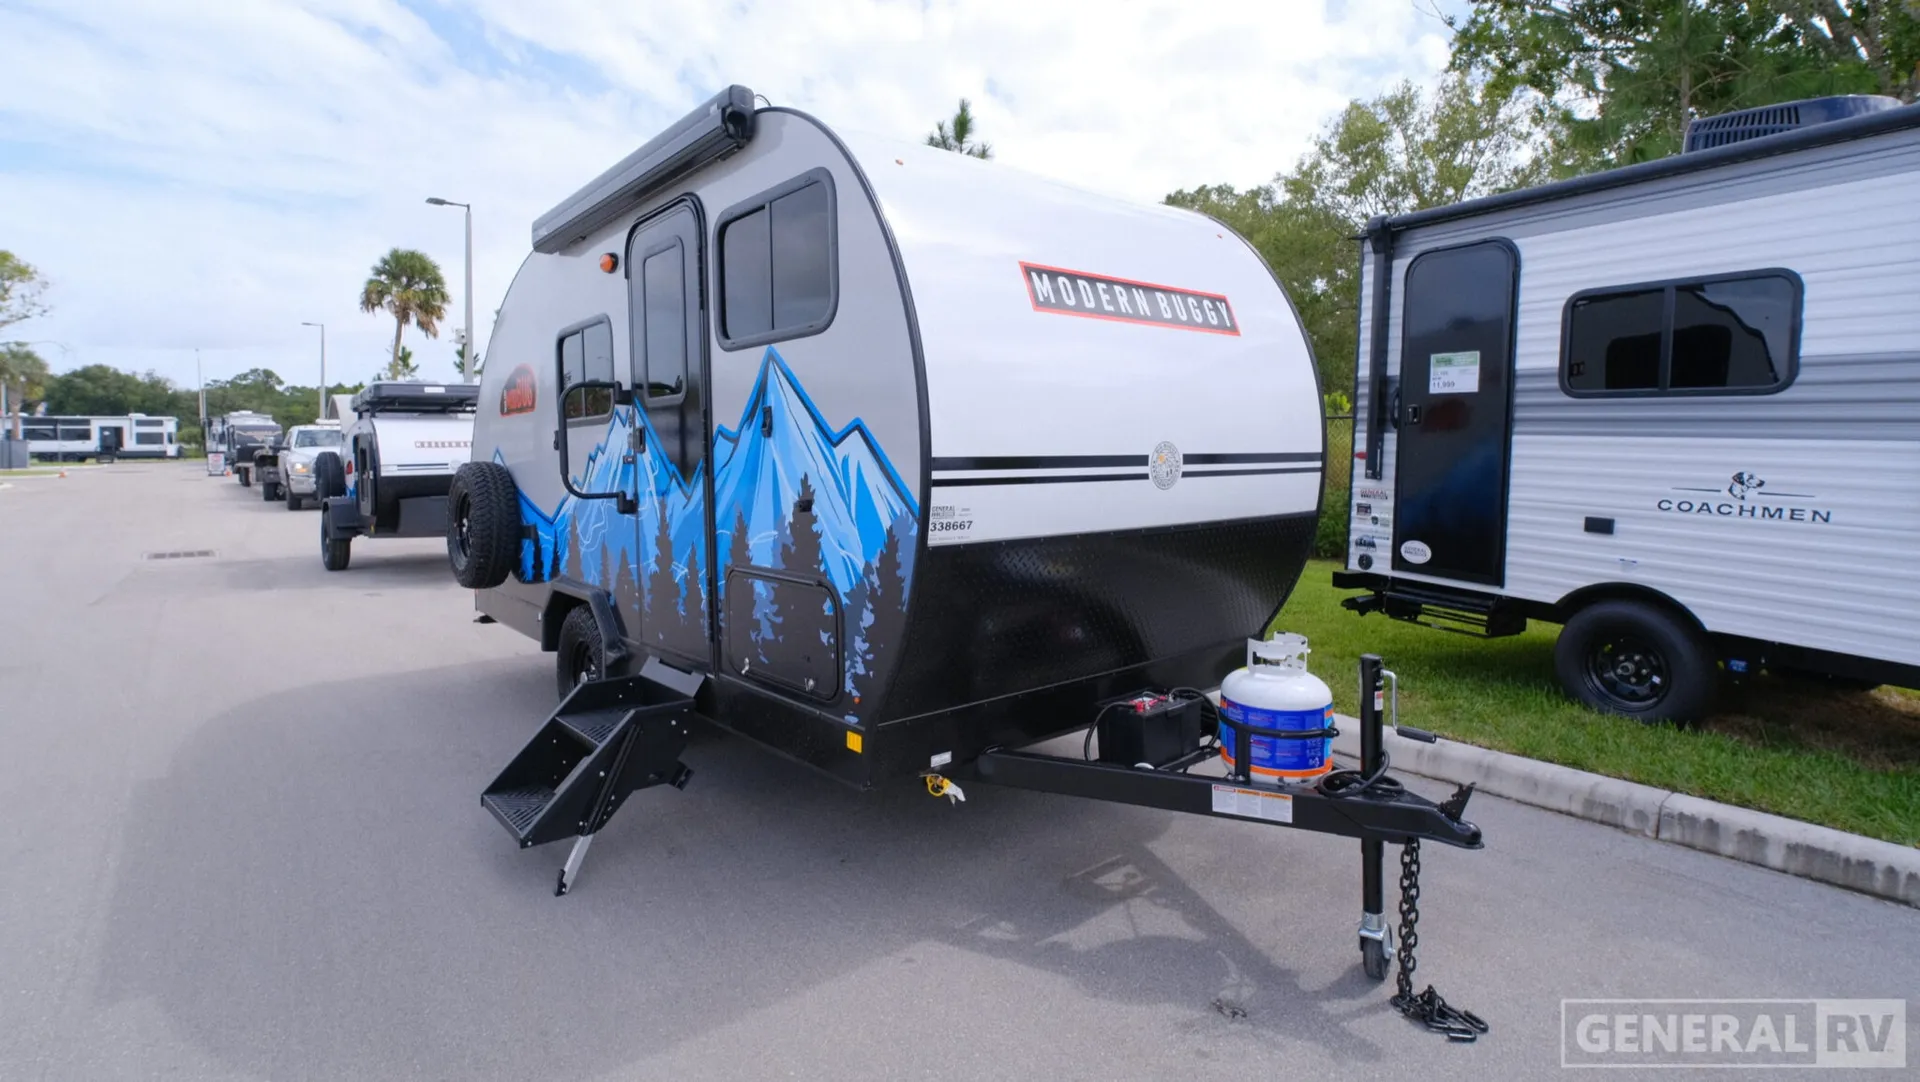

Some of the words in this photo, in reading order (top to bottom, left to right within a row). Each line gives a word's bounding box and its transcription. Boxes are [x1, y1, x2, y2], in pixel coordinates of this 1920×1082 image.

[1030, 271, 1152, 317] MODERN
[1159, 291, 1232, 328] BUGGY
[1657, 499, 1832, 523] COACHMEN
[930, 520, 973, 532] 338667
